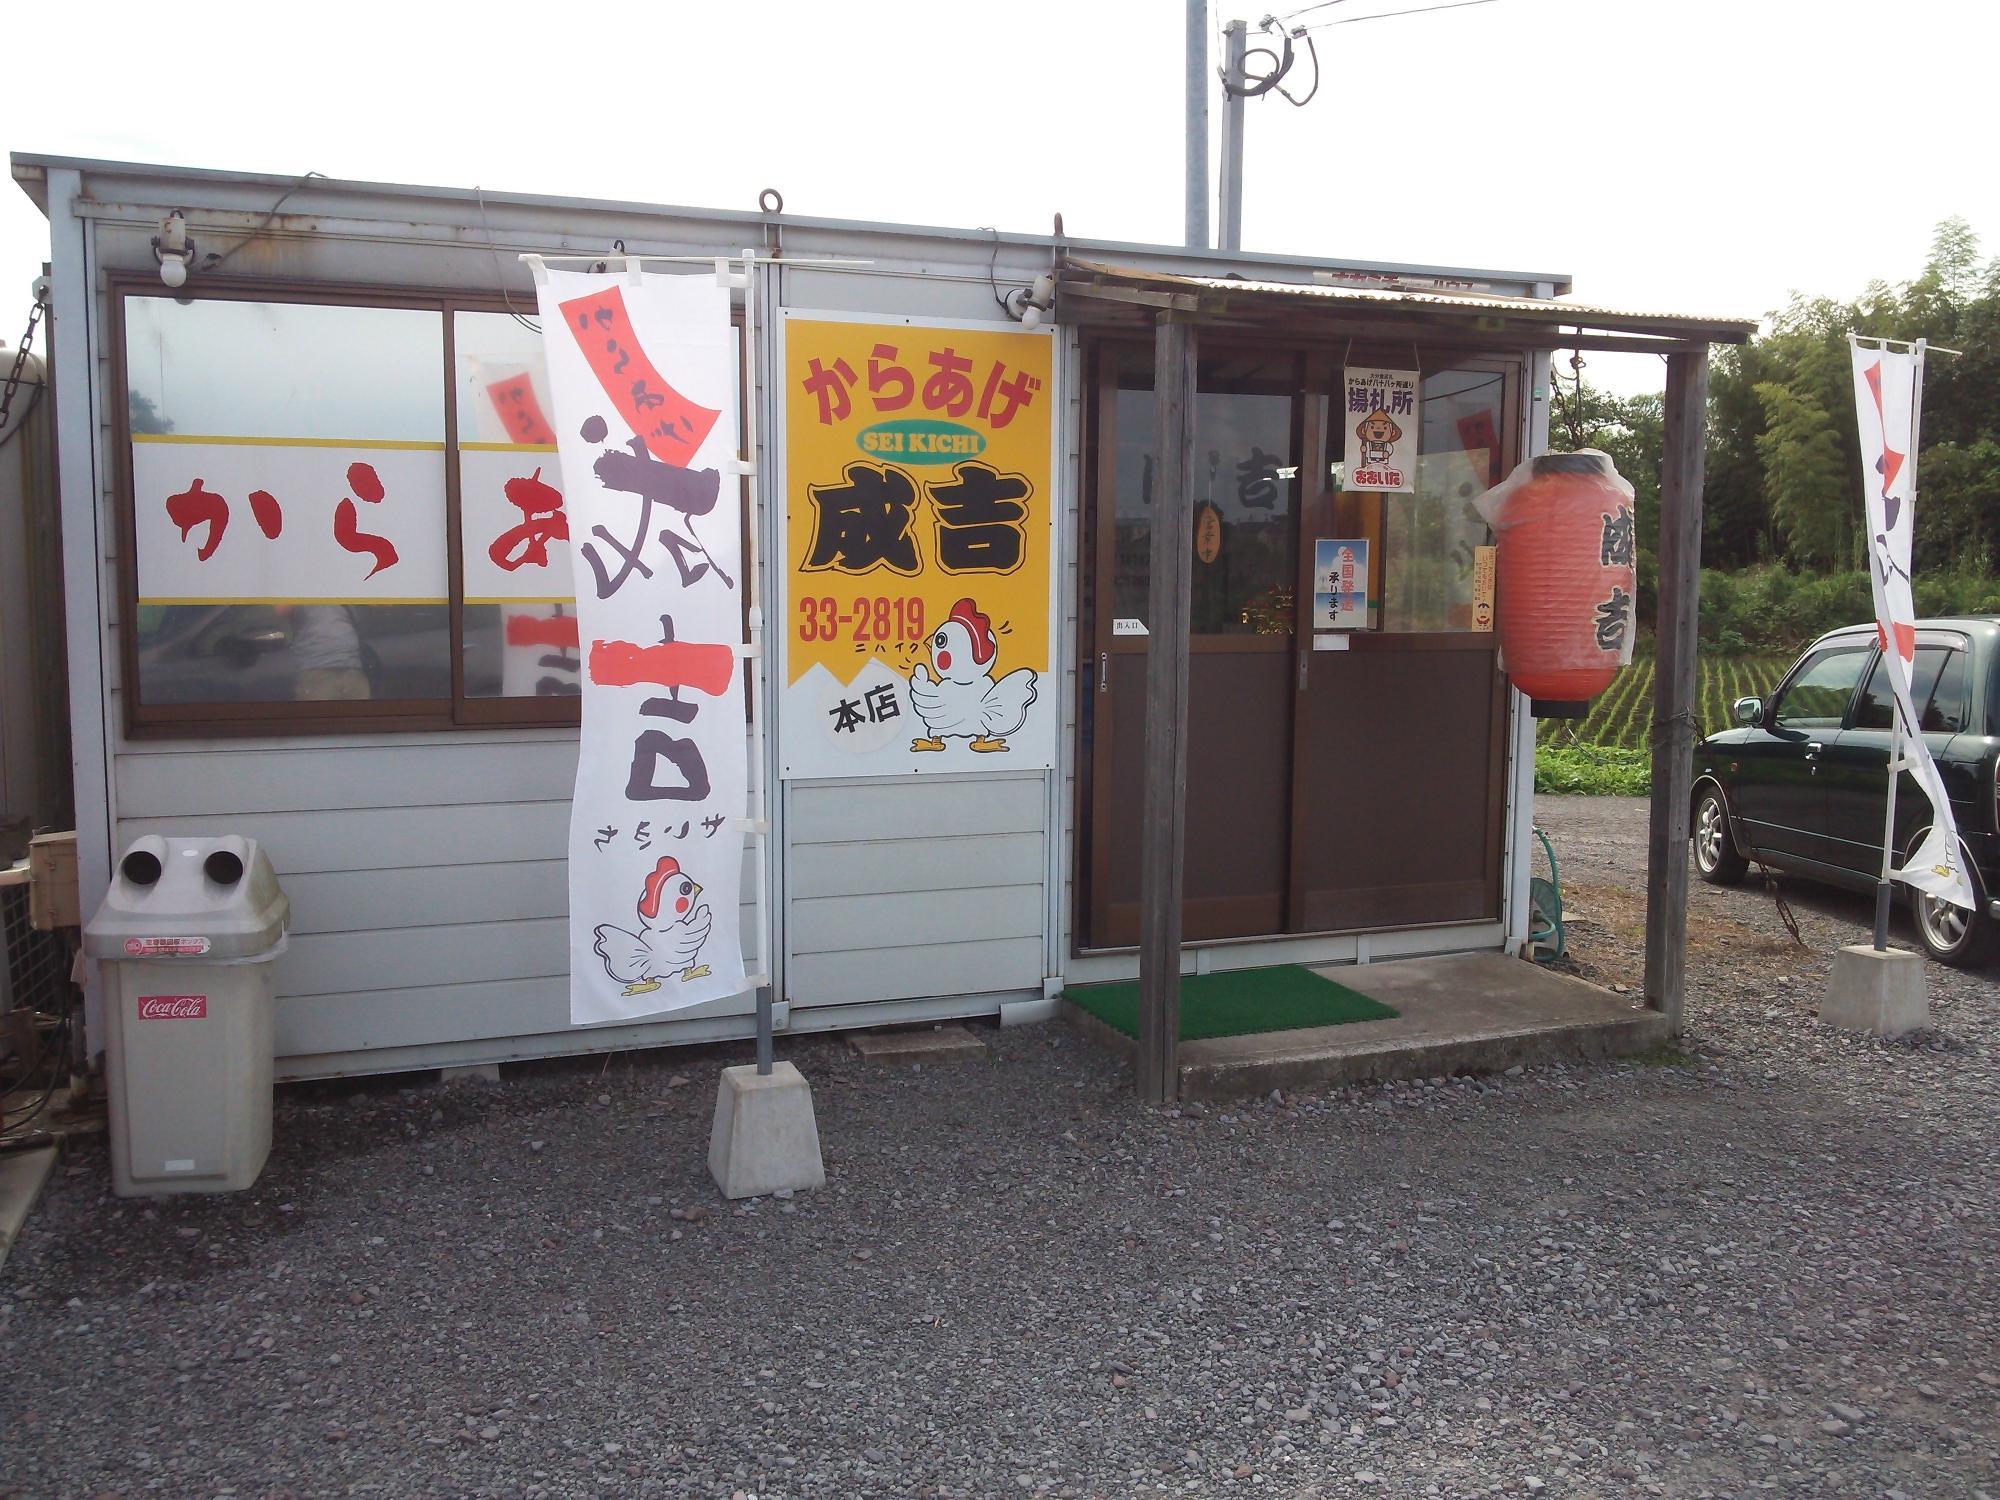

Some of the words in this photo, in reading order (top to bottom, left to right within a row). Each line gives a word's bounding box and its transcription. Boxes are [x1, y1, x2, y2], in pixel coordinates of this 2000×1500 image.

[802, 343, 1041, 429] からあげ
[1348, 387, 1414, 415] 揚札所
[863, 432, 905, 452] SEI
[908, 432, 979, 454] KICHI
[1355, 469, 1401, 486] おおいた
[801, 462, 1033, 576] 成吉
[1328, 572, 1340, 621] 承ります
[1341, 547, 1354, 612] 全国発送
[799, 597, 925, 642] 33-2819
[1116, 621, 1138, 630] 出入口
[854, 642, 919, 654] ニハイク
[828, 683, 901, 734] 本店
[142, 997, 204, 1018] Coca-Cola
